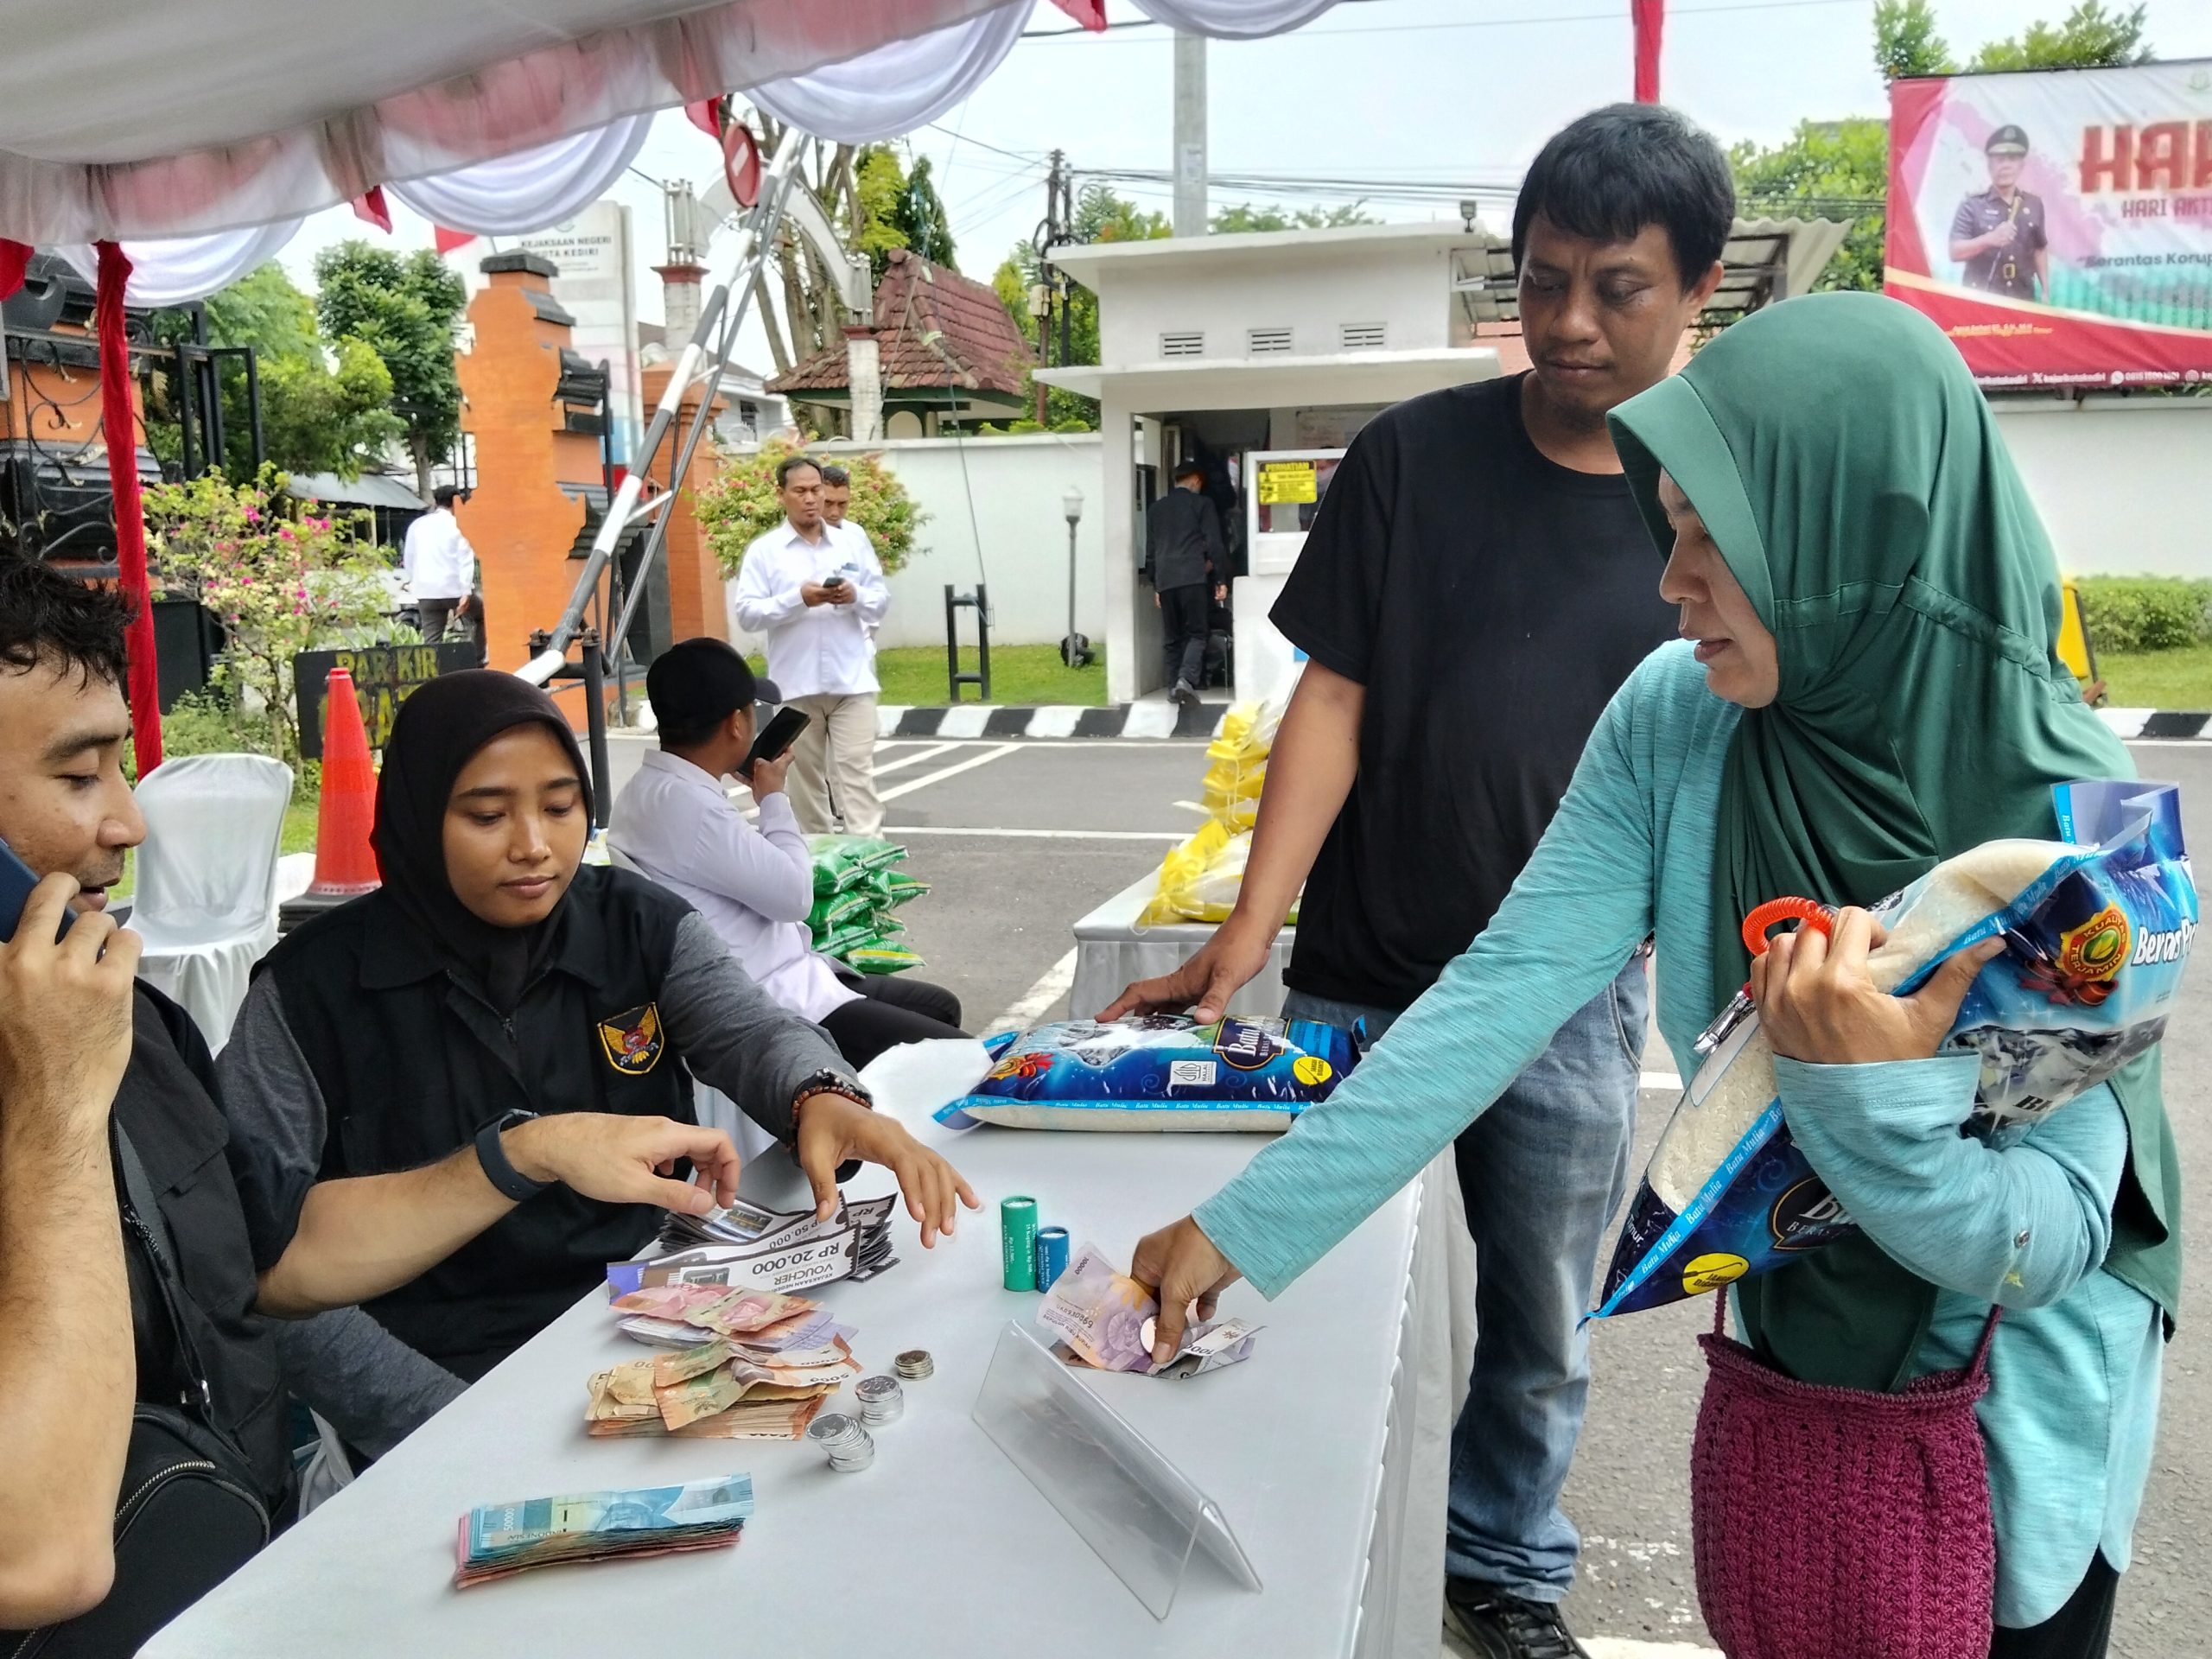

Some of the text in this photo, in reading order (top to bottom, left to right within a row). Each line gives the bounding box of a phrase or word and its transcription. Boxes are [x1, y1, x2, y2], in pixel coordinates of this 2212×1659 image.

[2120, 198, 2168, 219] HARI
[521, 236, 612, 248] KEJAKSAAN NEGERI
[564, 248, 599, 257] KEDIRI
[335, 647, 438, 683] PARKIR
[2062, 814, 2072, 837] Batu
[1963, 925, 1986, 945] Batu
[2083, 916, 2126, 943] KUALITAS
[2071, 944, 2121, 974] TERJAMIN
[1227, 1027, 1261, 1057] Batu
[852, 1206, 875, 1217] RP
[1641, 1253, 1659, 1274] Batu
[1657, 1230, 1681, 1255] Mulia
[1685, 1204, 1705, 1225] Batu
[1700, 1179, 1723, 1209] Mulia
[1726, 1154, 1744, 1176] Batu
[1741, 1128, 1765, 1156] Mulia
[769, 1224, 809, 1250] 50.000
[818, 1242, 840, 1258] RP
[752, 1249, 816, 1275] 20.000
[774, 1263, 834, 1286] VOUCHER
[794, 1272, 833, 1287] KEJAKSAAN
[1065, 1325, 1076, 1336] RIBU
[810, 1372, 849, 1382] 5000
[503, 1507, 516, 1532] 50000
